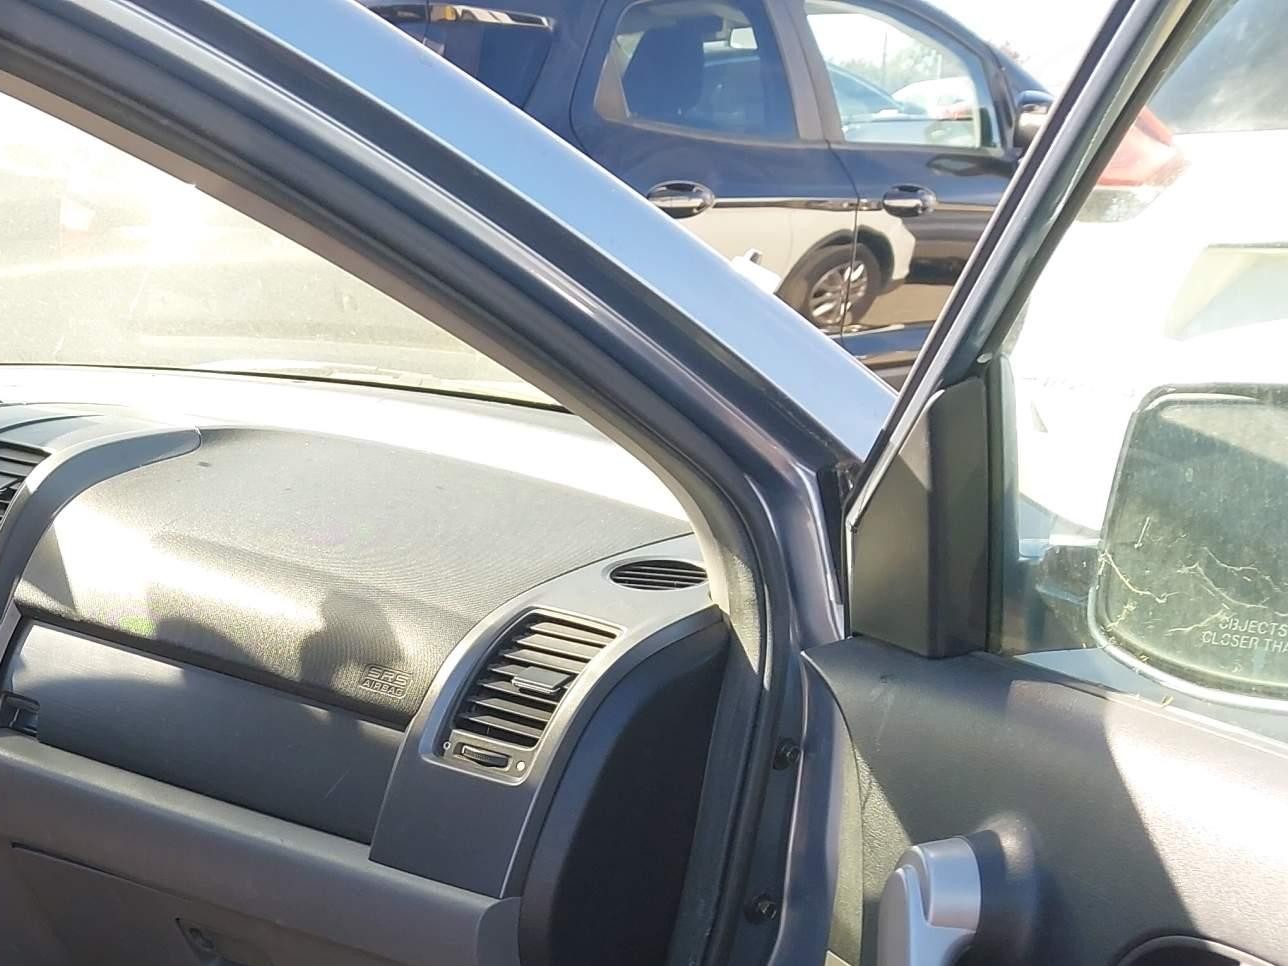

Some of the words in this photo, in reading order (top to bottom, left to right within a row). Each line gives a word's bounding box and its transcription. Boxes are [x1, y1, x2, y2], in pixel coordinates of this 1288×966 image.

[1219, 616, 1288, 637] OBJECTS
[1202, 630, 1259, 650] CLOSER
[368, 667, 409, 686] SRS
[362, 679, 404, 696] AIRBAG
